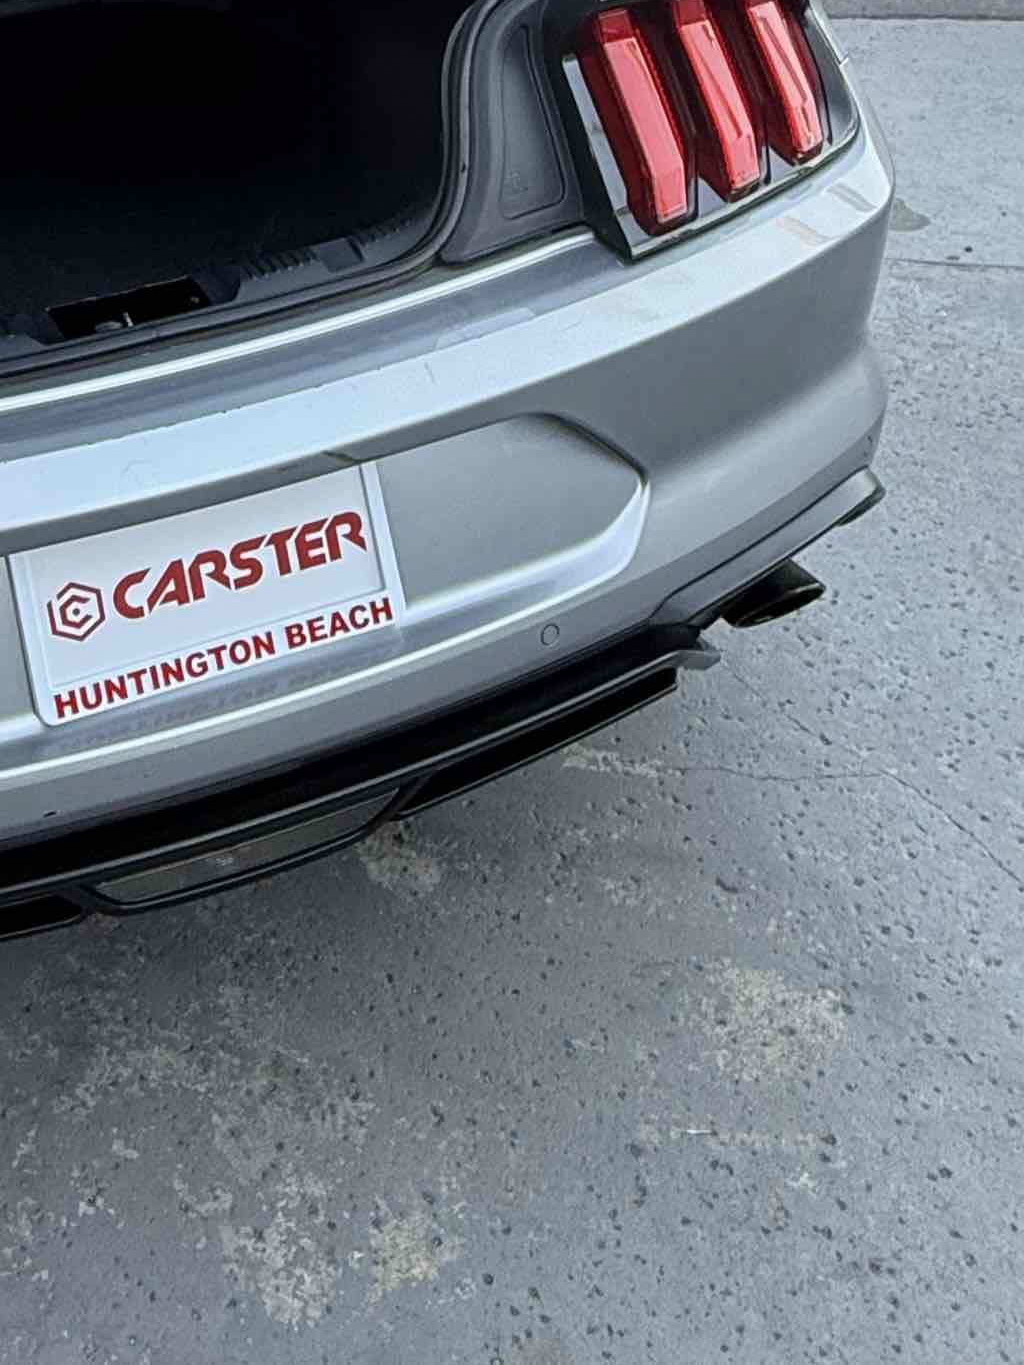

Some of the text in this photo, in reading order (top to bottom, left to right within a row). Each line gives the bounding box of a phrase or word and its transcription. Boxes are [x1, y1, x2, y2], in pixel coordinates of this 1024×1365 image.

[112, 511, 368, 619] CARSTER
[53, 597, 394, 719] HUNTINGTON BEACH
